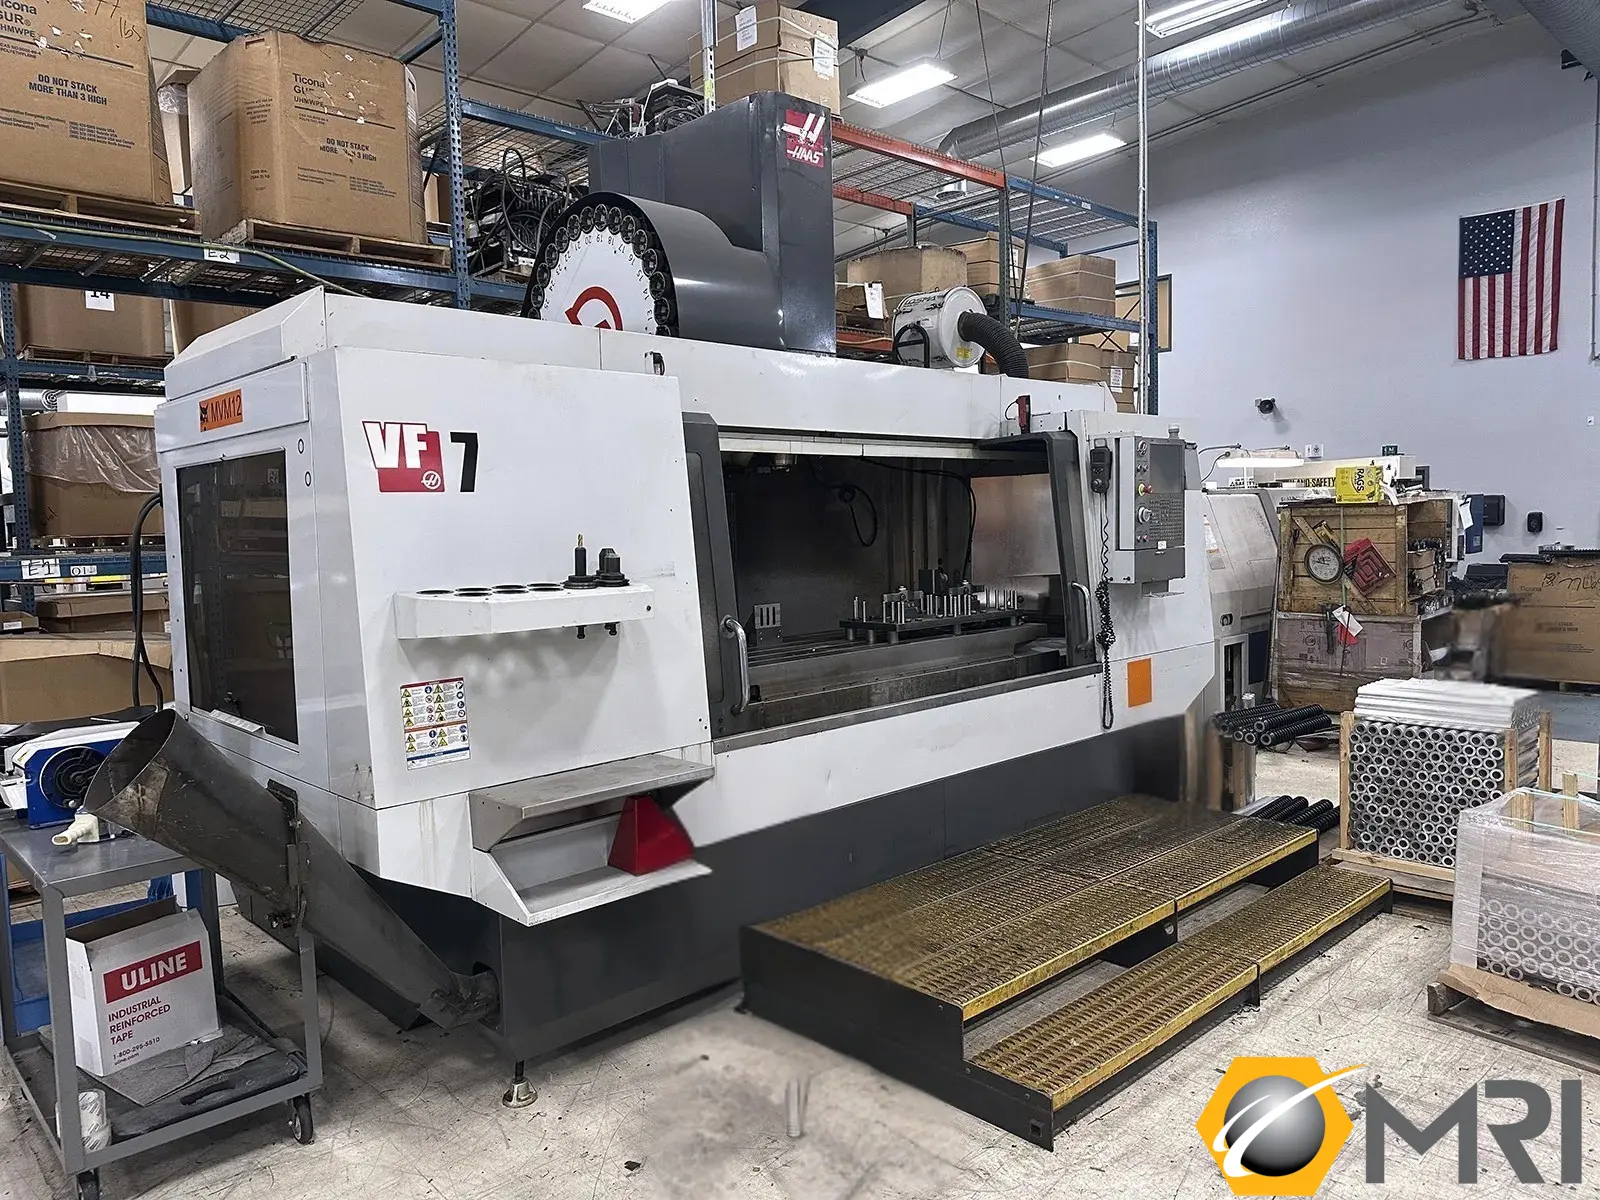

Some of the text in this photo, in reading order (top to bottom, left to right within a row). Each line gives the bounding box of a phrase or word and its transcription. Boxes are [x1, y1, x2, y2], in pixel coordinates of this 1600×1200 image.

[0, 0, 37, 15] icona
[0, 24, 35, 37] HMWPE
[38, 74, 97, 93] DO NOT STACK
[292, 73, 325, 88] Ticona
[29, 82, 54, 94] MORE
[56, 87, 78, 99] THAN
[88, 95, 107, 105] HIGH
[320, 146, 338, 154] MORE
[326, 137, 370, 151] DO NOT STACK
[787, 146, 823, 164] HAAS
[211, 395, 242, 422] MVM12
[361, 421, 478, 492] VF 7
[1357, 468, 1365, 491] RAGS
[121, 952, 187, 990] ULINE
[108, 996, 161, 1022] INDUSTRIAL
[109, 1004, 171, 1034] REINFORCED
[110, 1030, 133, 1045] TAPE
